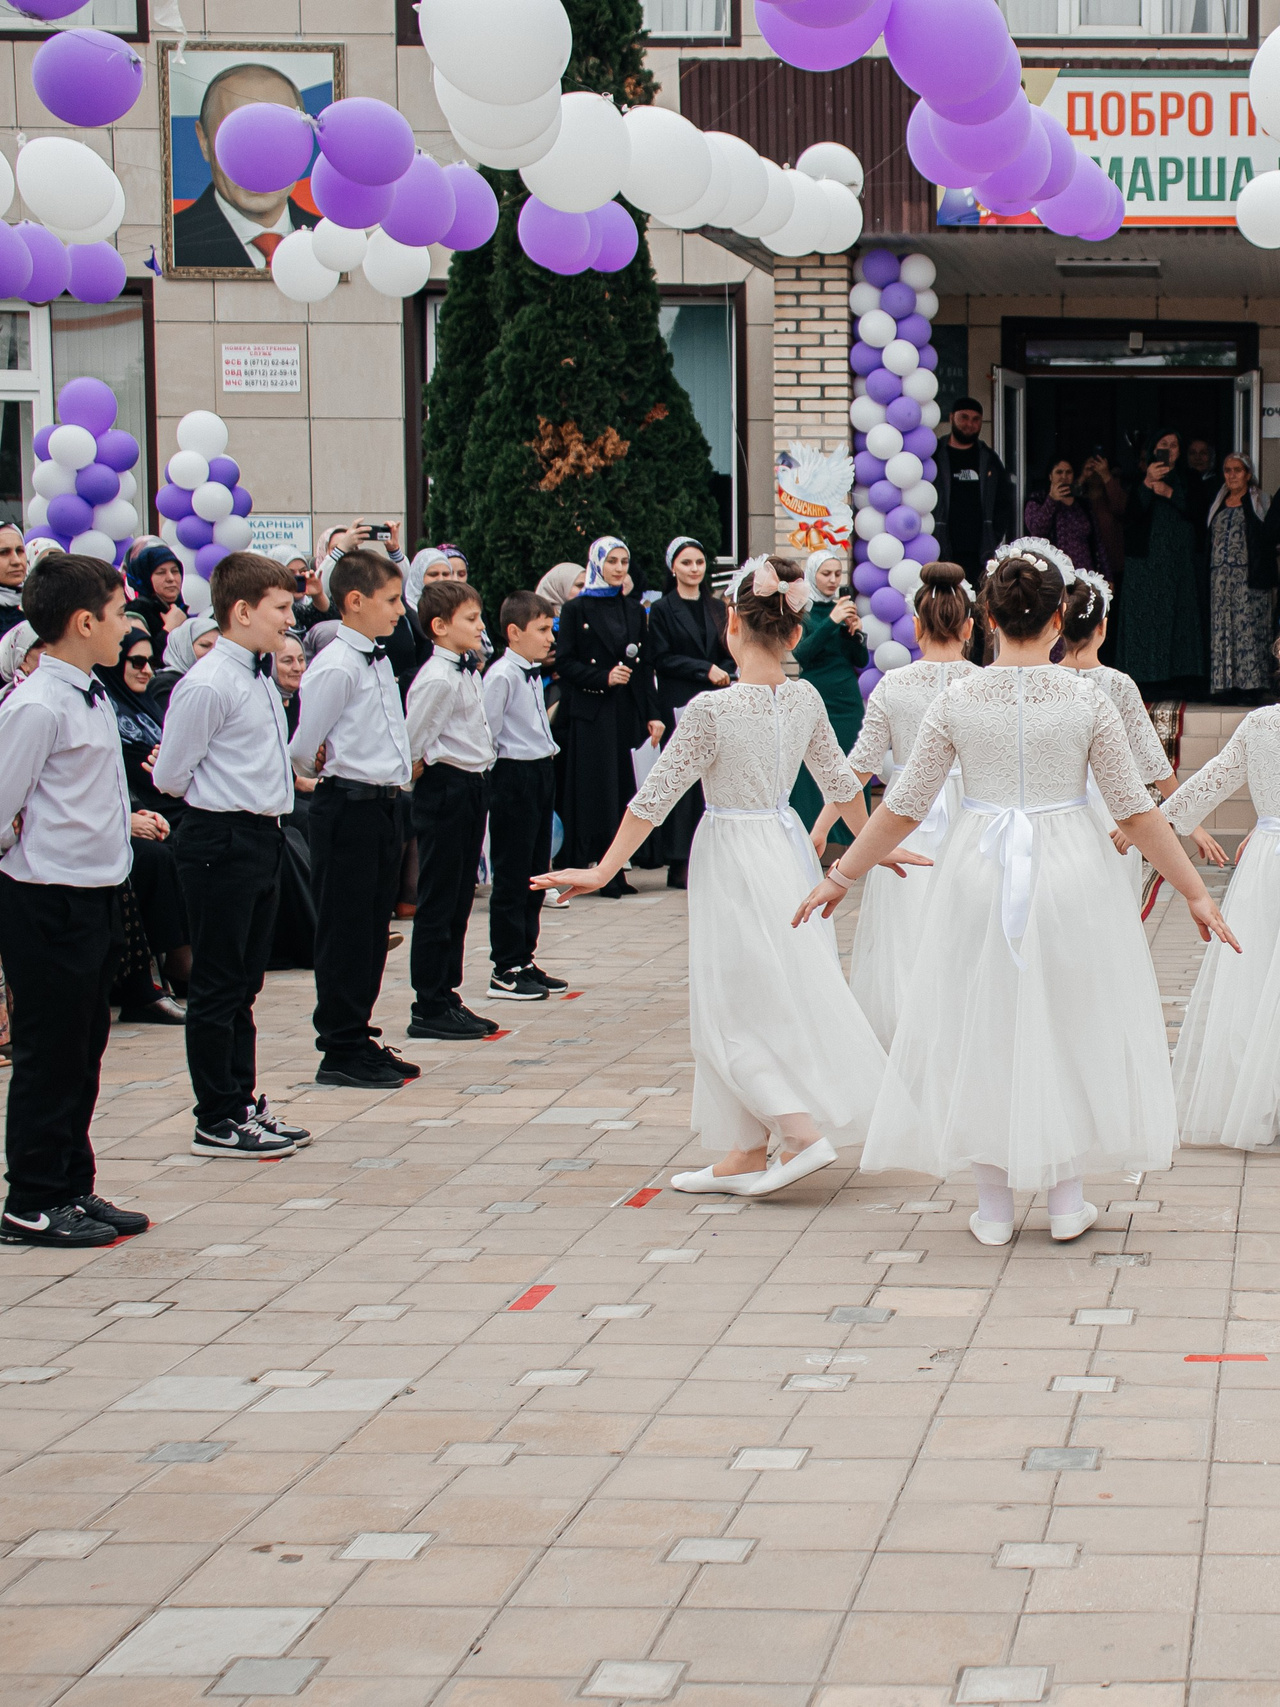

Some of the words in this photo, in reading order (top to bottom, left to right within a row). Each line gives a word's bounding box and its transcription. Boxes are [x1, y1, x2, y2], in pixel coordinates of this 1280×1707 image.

[1066, 90, 1214, 141] ДОБРО
[224, 369, 242, 377] ОВД
[780, 491, 829, 518] ВЫПУСКНИК
[247, 519, 304, 529] ЖАРНЫЙ
[252, 531, 294, 540] ДОЕМ
